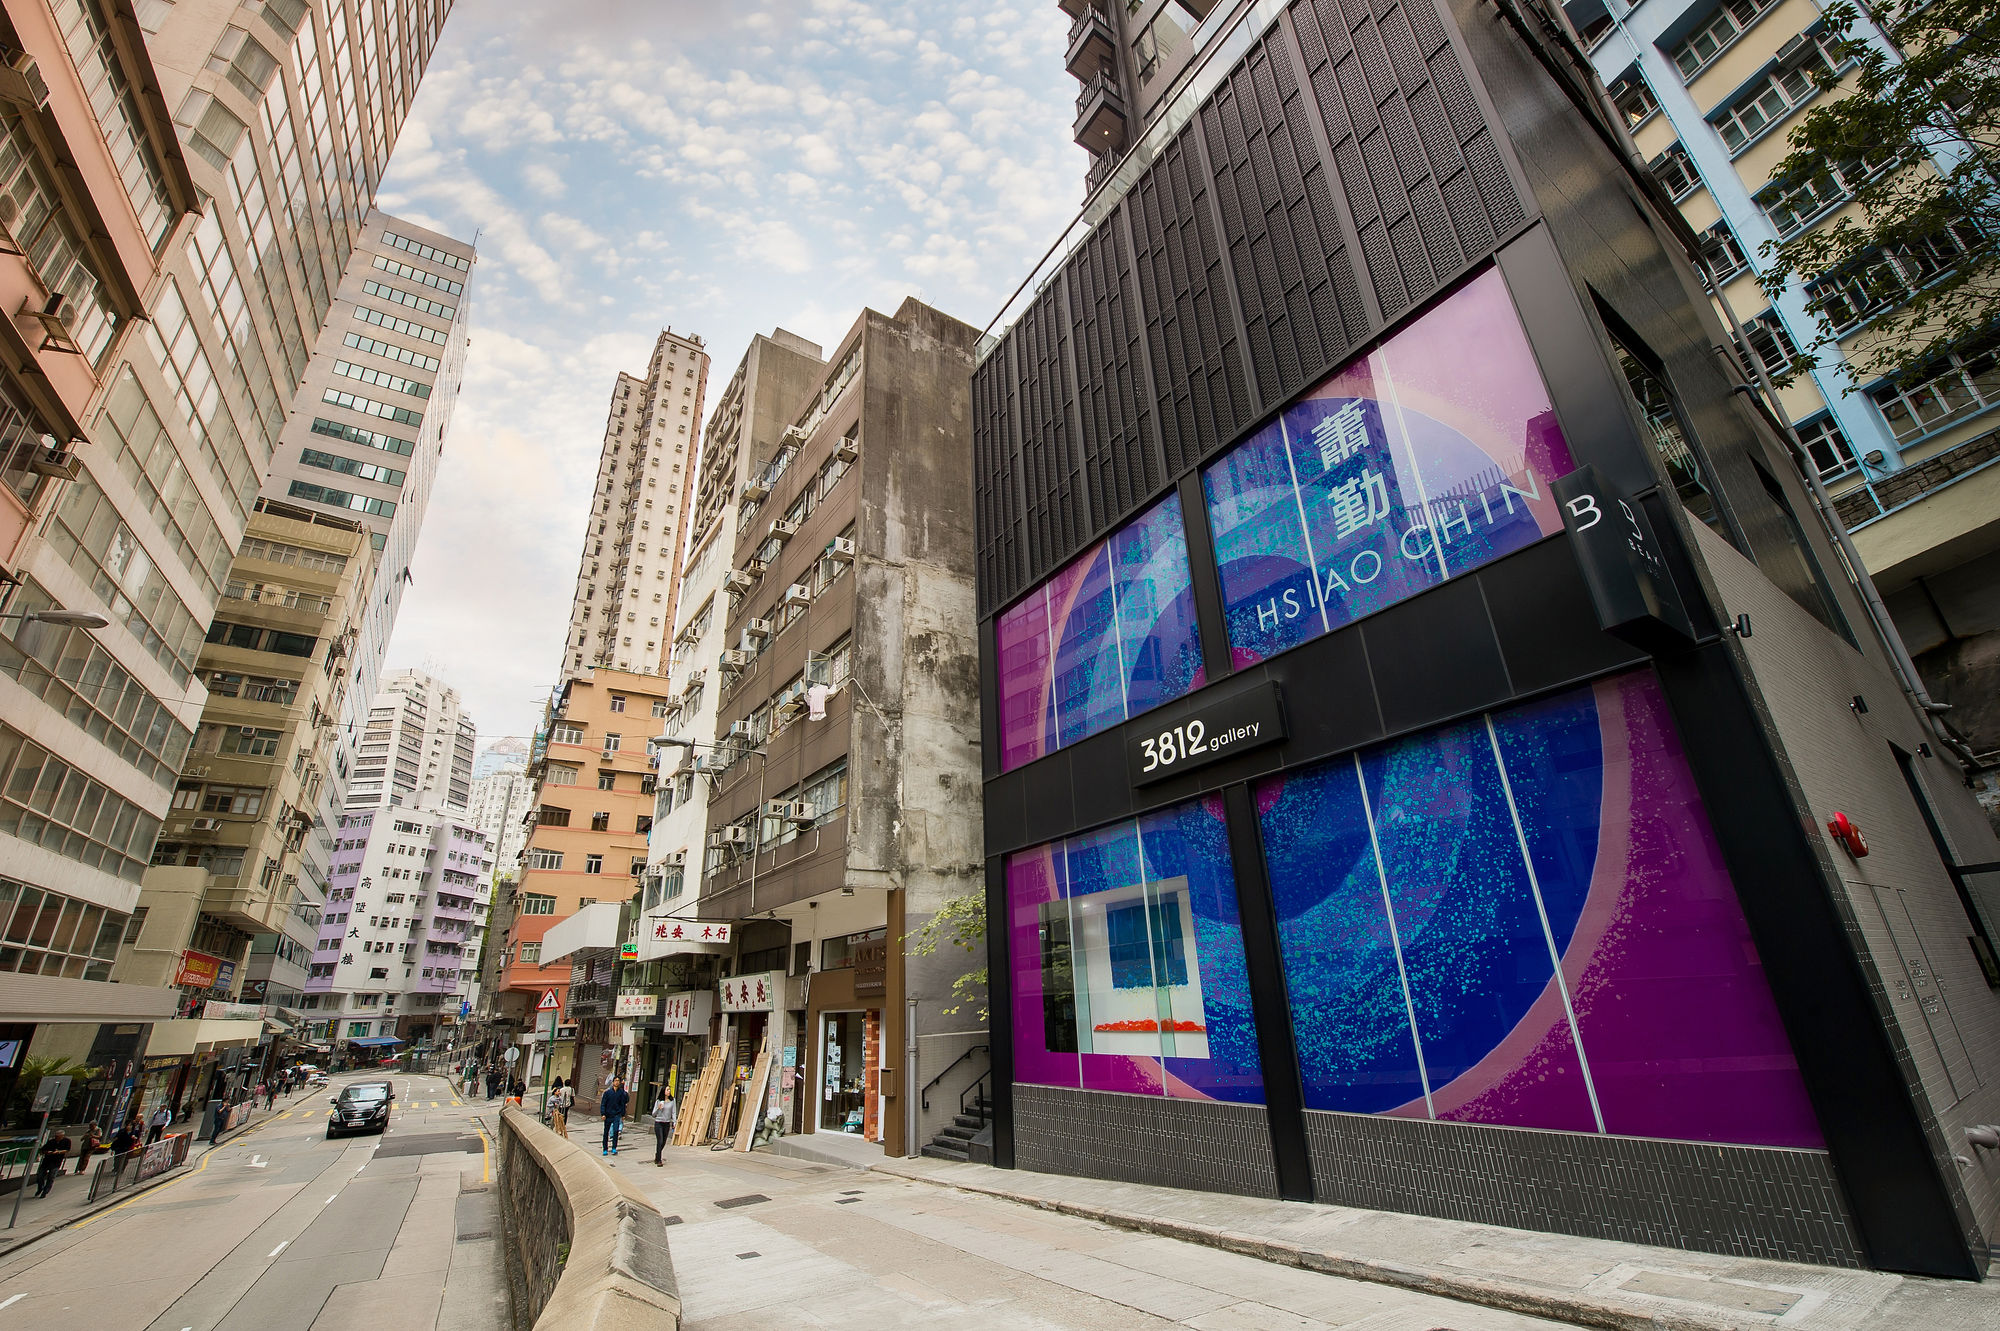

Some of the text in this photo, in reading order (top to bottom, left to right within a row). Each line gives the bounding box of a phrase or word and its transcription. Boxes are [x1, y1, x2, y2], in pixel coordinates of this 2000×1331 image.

[1311, 397, 1391, 540] 蕭勤
[1565, 494, 1601, 532] B
[1256, 469, 1541, 632] HSIAO CHIN
[1140, 719, 1260, 773] 3812 gallery
[655, 923, 727, 940] 兆安 木行
